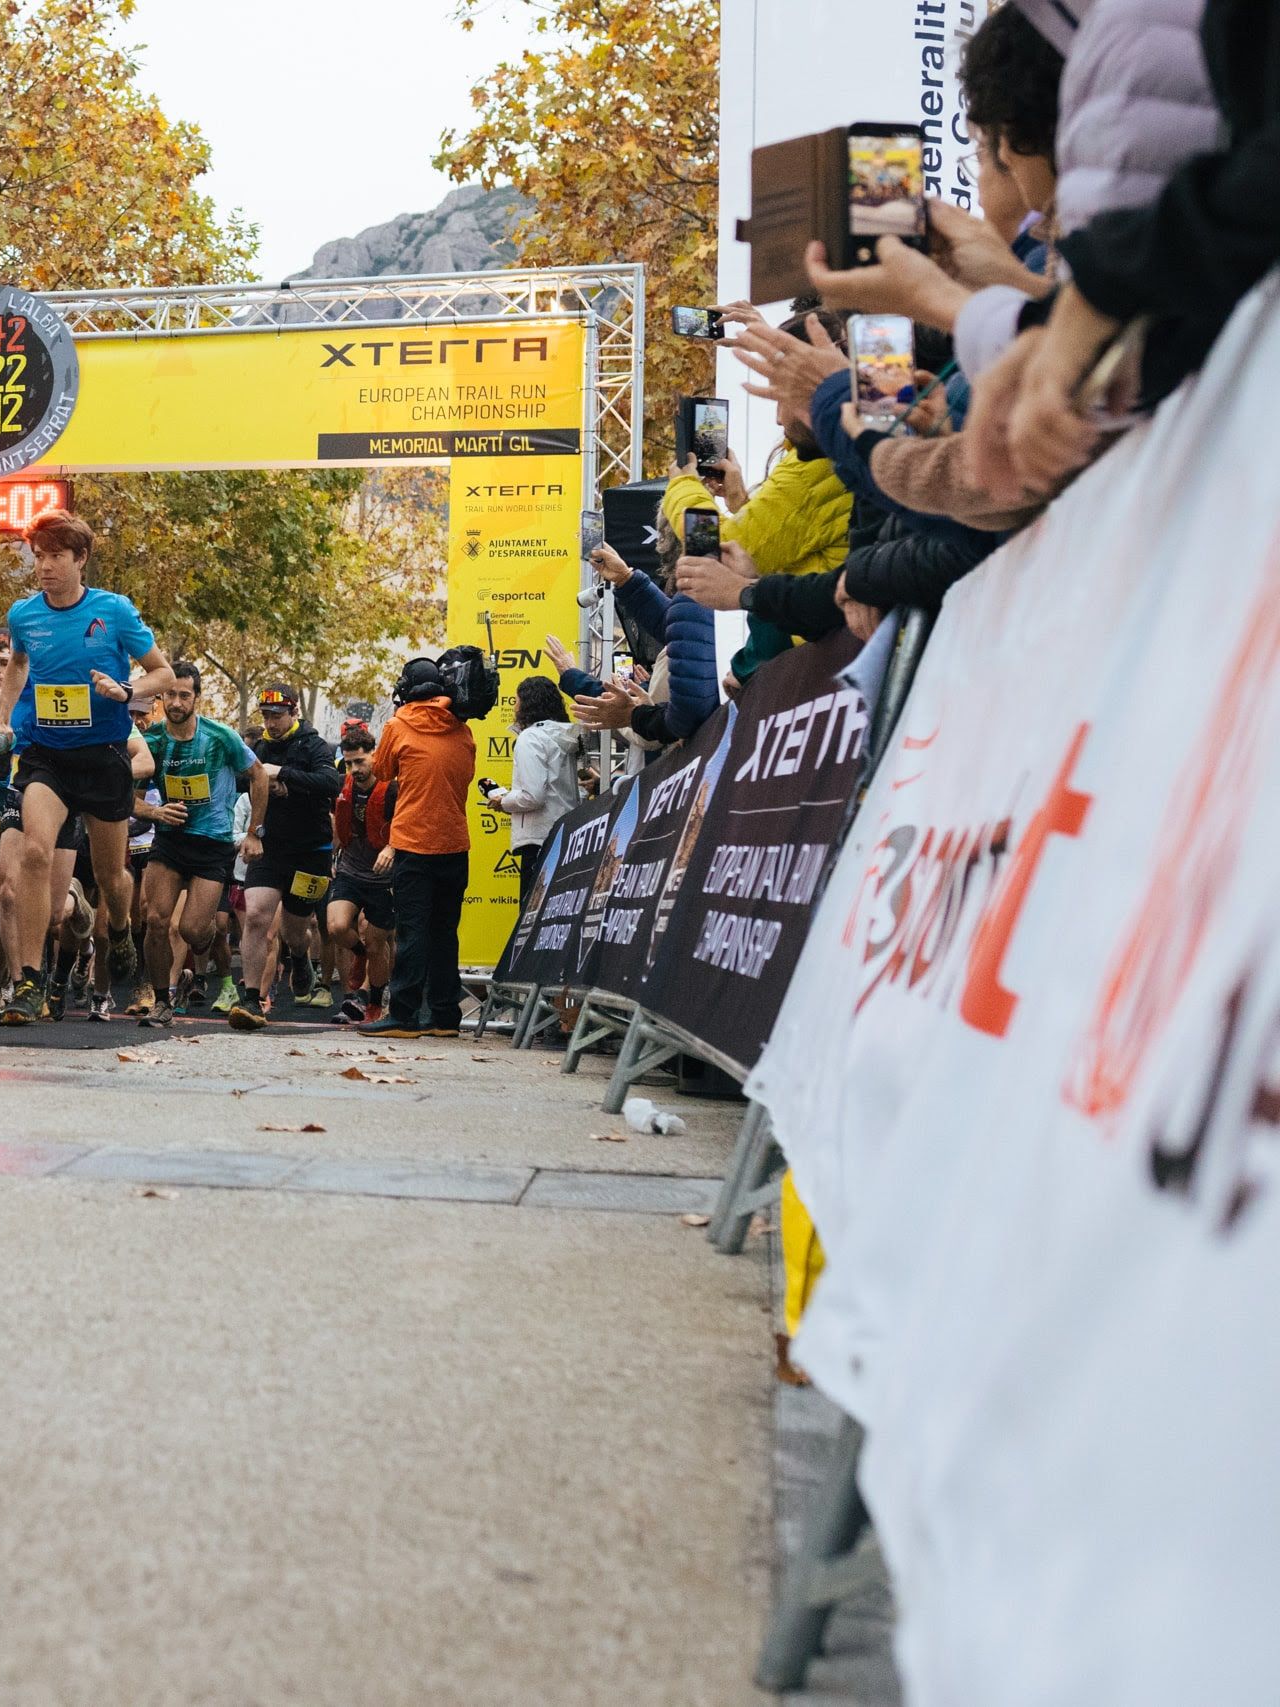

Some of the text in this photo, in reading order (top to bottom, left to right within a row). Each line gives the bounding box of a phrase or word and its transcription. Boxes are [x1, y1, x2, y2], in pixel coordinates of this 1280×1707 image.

[7, 293, 61, 338] L'ALBA
[320, 337, 548, 367] XTERRA
[359, 384, 547, 404] EUROPEAN TRAIL RUN
[412, 403, 547, 421] CHAMPIONSHIP
[370, 431, 535, 455] MEMORIAL MARTÍ GIL
[466, 484, 563, 497] XTERRA
[465, 504, 562, 513] TRAIL RUN WORLD SERIES
[489, 539, 548, 548] AJUNTAMENT
[488, 549, 568, 558] D'ESPARREGUERA
[491, 591, 546, 603] esportcat
[52, 699, 69, 713] 15
[182, 786, 192, 796] 11
[307, 885, 317, 895] 51
